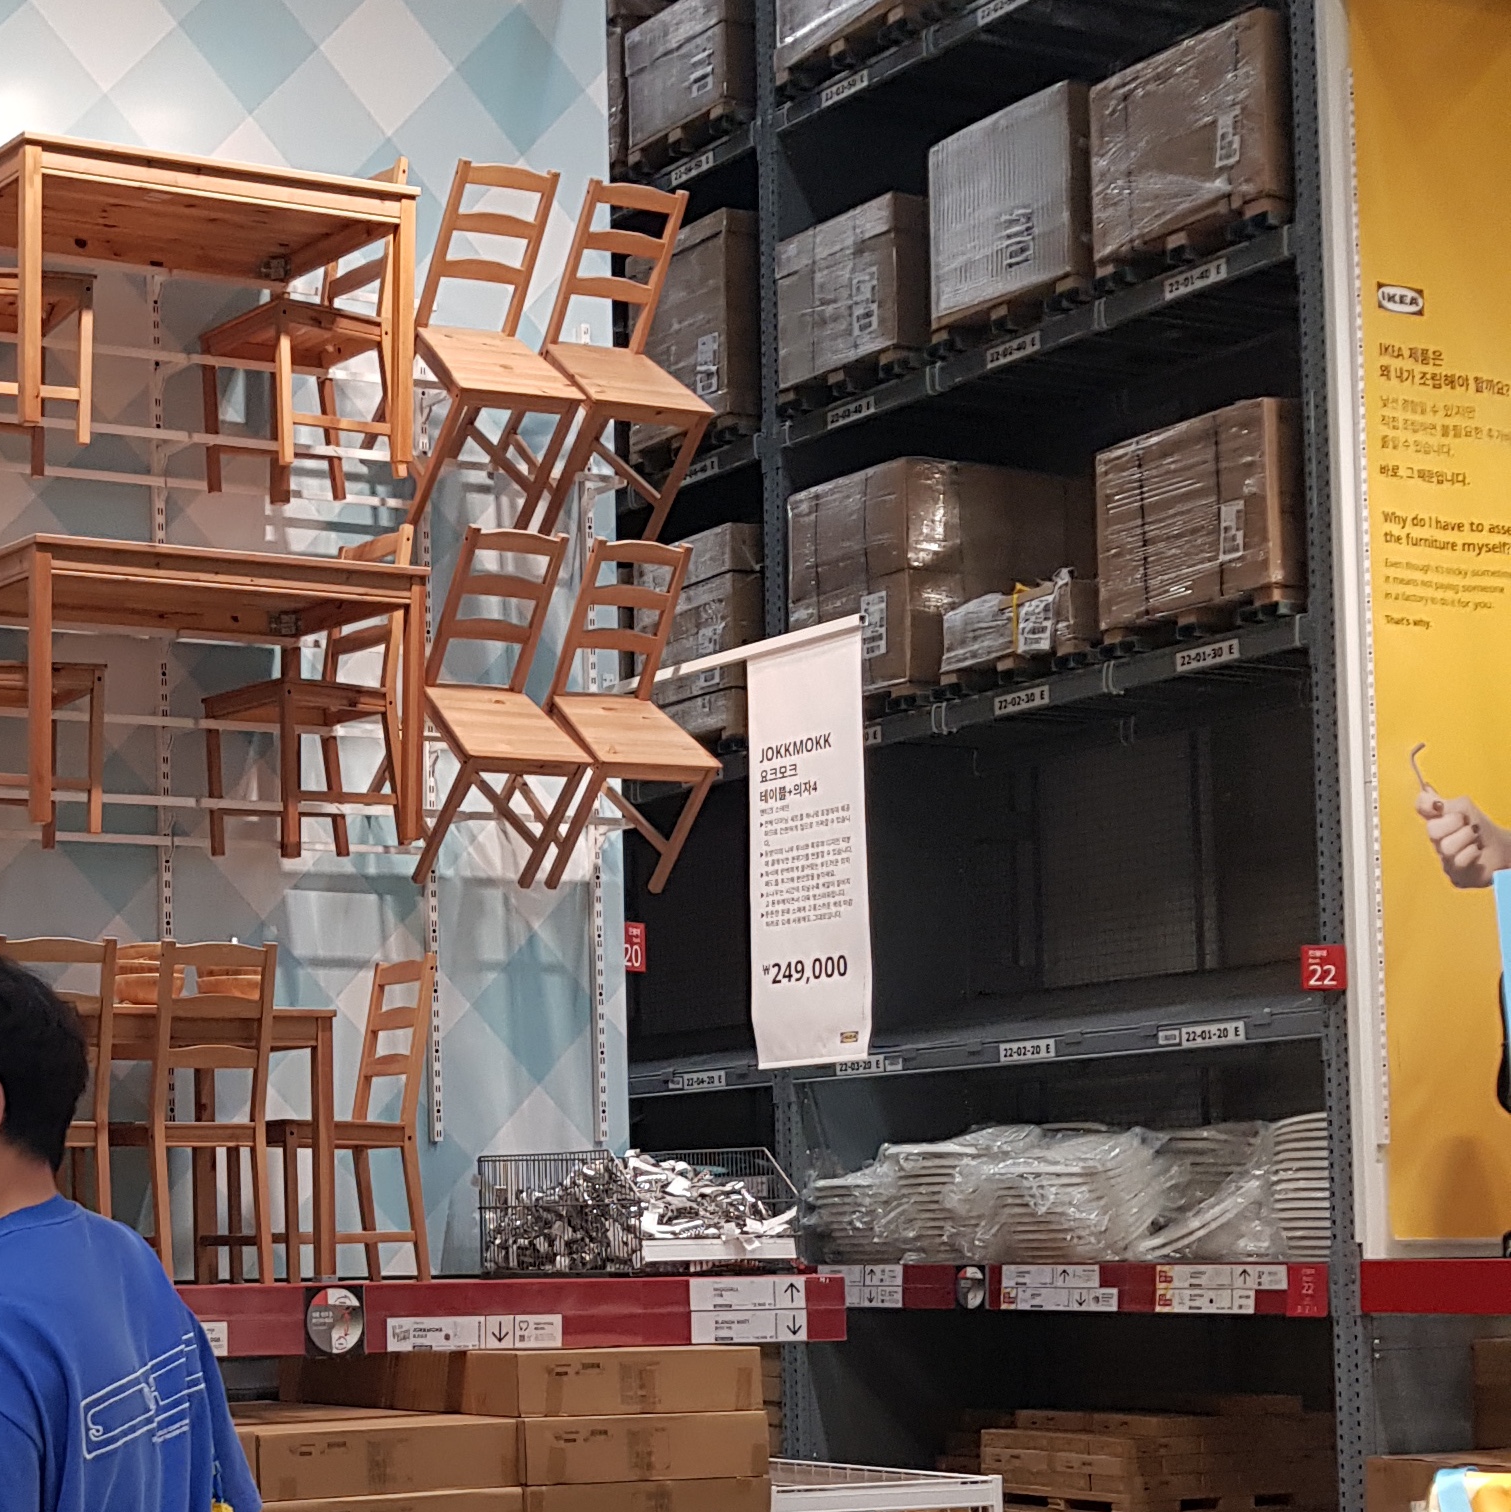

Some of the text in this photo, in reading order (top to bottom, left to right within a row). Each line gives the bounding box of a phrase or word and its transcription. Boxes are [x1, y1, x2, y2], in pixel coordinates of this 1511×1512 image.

[1381, 290, 1420, 307] IKEA
[1379, 342, 1445, 367] IKEA 제품은
[1379, 364, 1392, 381] 왜
[1394, 367, 1415, 385] 내가
[1418, 371, 1470, 392] 조립해야
[1379, 463, 1404, 479] 바로,
[1405, 466, 1415, 479] 그
[1381, 510, 1408, 529] Why
[1411, 513, 1426, 528] do
[1435, 516, 1465, 532] have
[1469, 520, 1485, 533] to
[1383, 530, 1403, 545] the
[1405, 532, 1458, 552] furniture
[1179, 648, 1224, 667] 22-01-30
[997, 691, 1036, 709] 22-02-30
[759, 731, 832, 764] JOKKMOKK
[759, 763, 799, 784] 요크모크
[759, 779, 818, 804] 테이블+의자4
[624, 943, 642, 968] 20
[762, 954, 848, 985] ₩249,000
[1308, 964, 1338, 986] 22
[1185, 1026, 1229, 1042] 22-01-20
[1002, 1044, 1041, 1058] 22-02-20
[839, 1061, 872, 1072] 22-03-20
[1301, 1282, 1314, 1295] 22
